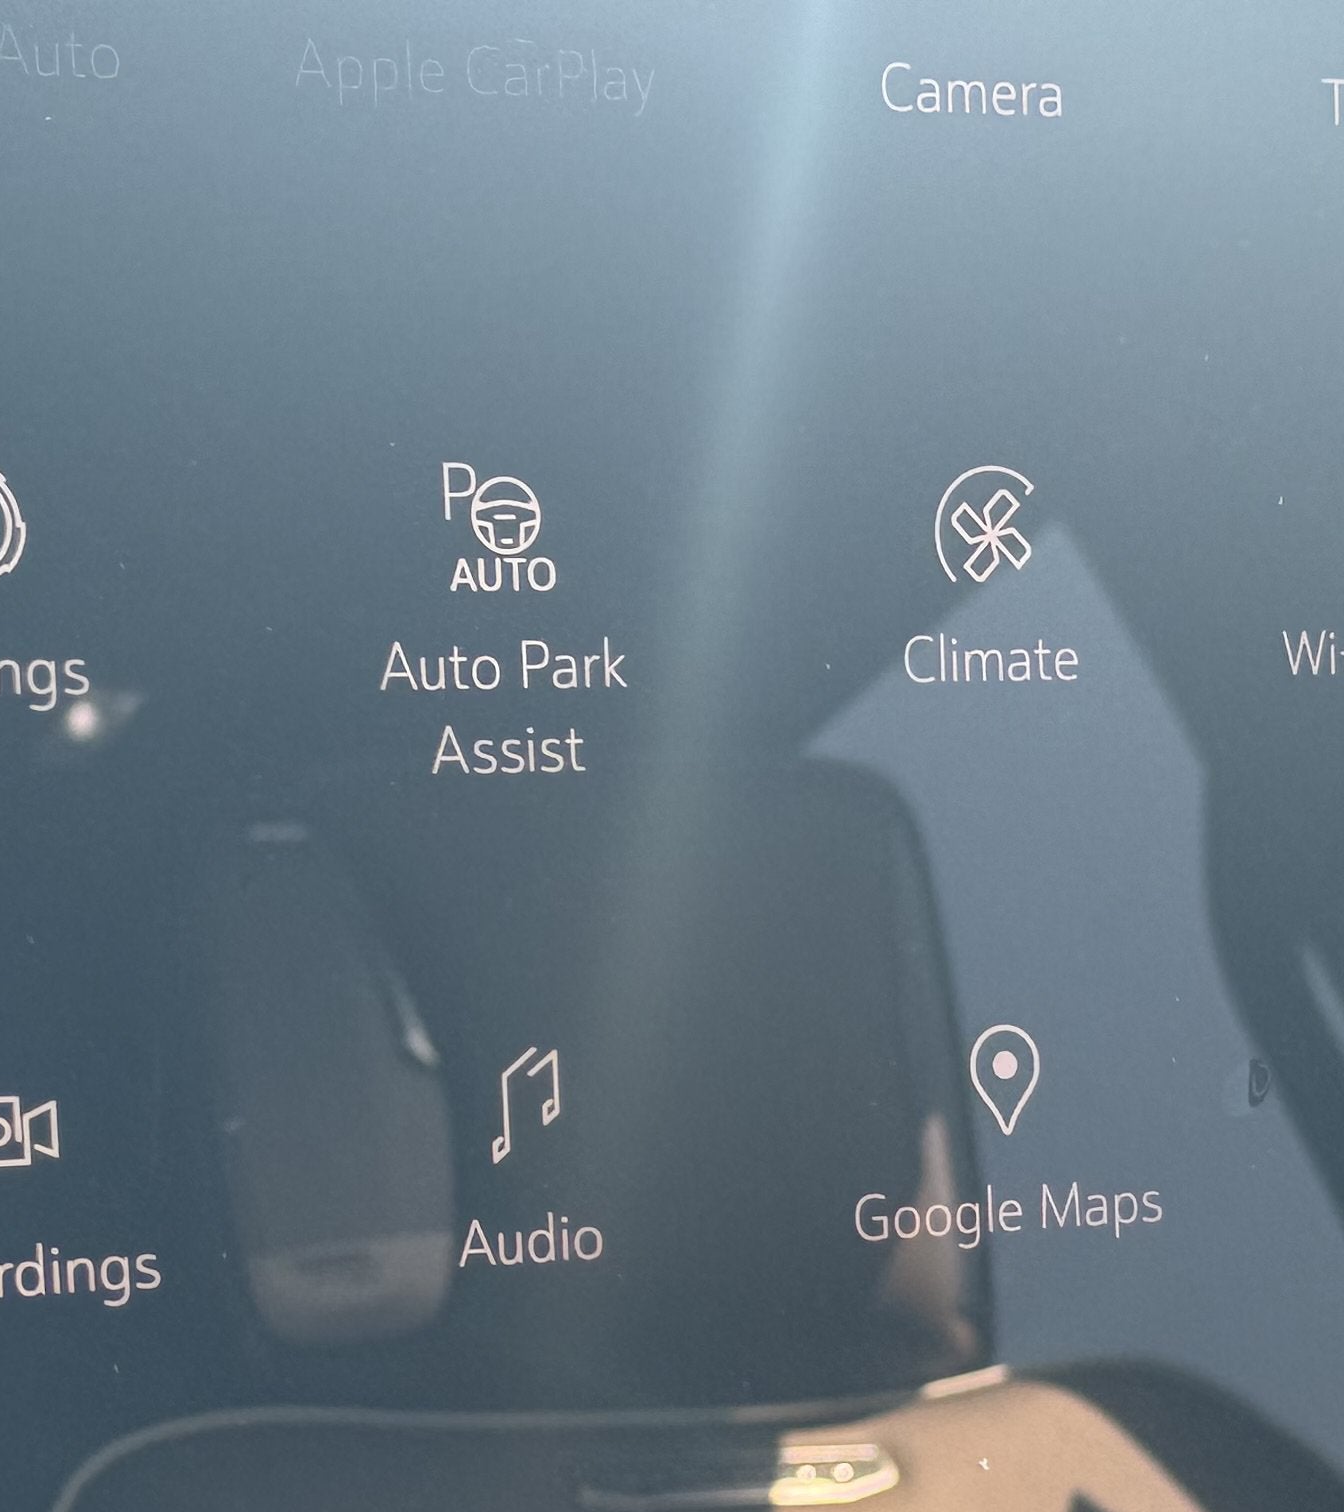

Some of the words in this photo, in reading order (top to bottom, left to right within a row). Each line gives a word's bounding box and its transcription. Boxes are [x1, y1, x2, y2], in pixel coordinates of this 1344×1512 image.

[292, 36, 446, 108] Apple
[465, 40, 655, 117] CarPlay
[880, 61, 1064, 119] Camera
[449, 557, 558, 593] AUTO
[379, 640, 502, 693] Auto
[519, 636, 628, 691] Park
[903, 633, 1080, 685] Climate
[430, 725, 587, 776] Assist
[458, 1211, 605, 1269] Audio
[854, 1186, 1024, 1250] Google
[1040, 1180, 1165, 1239] Maps
